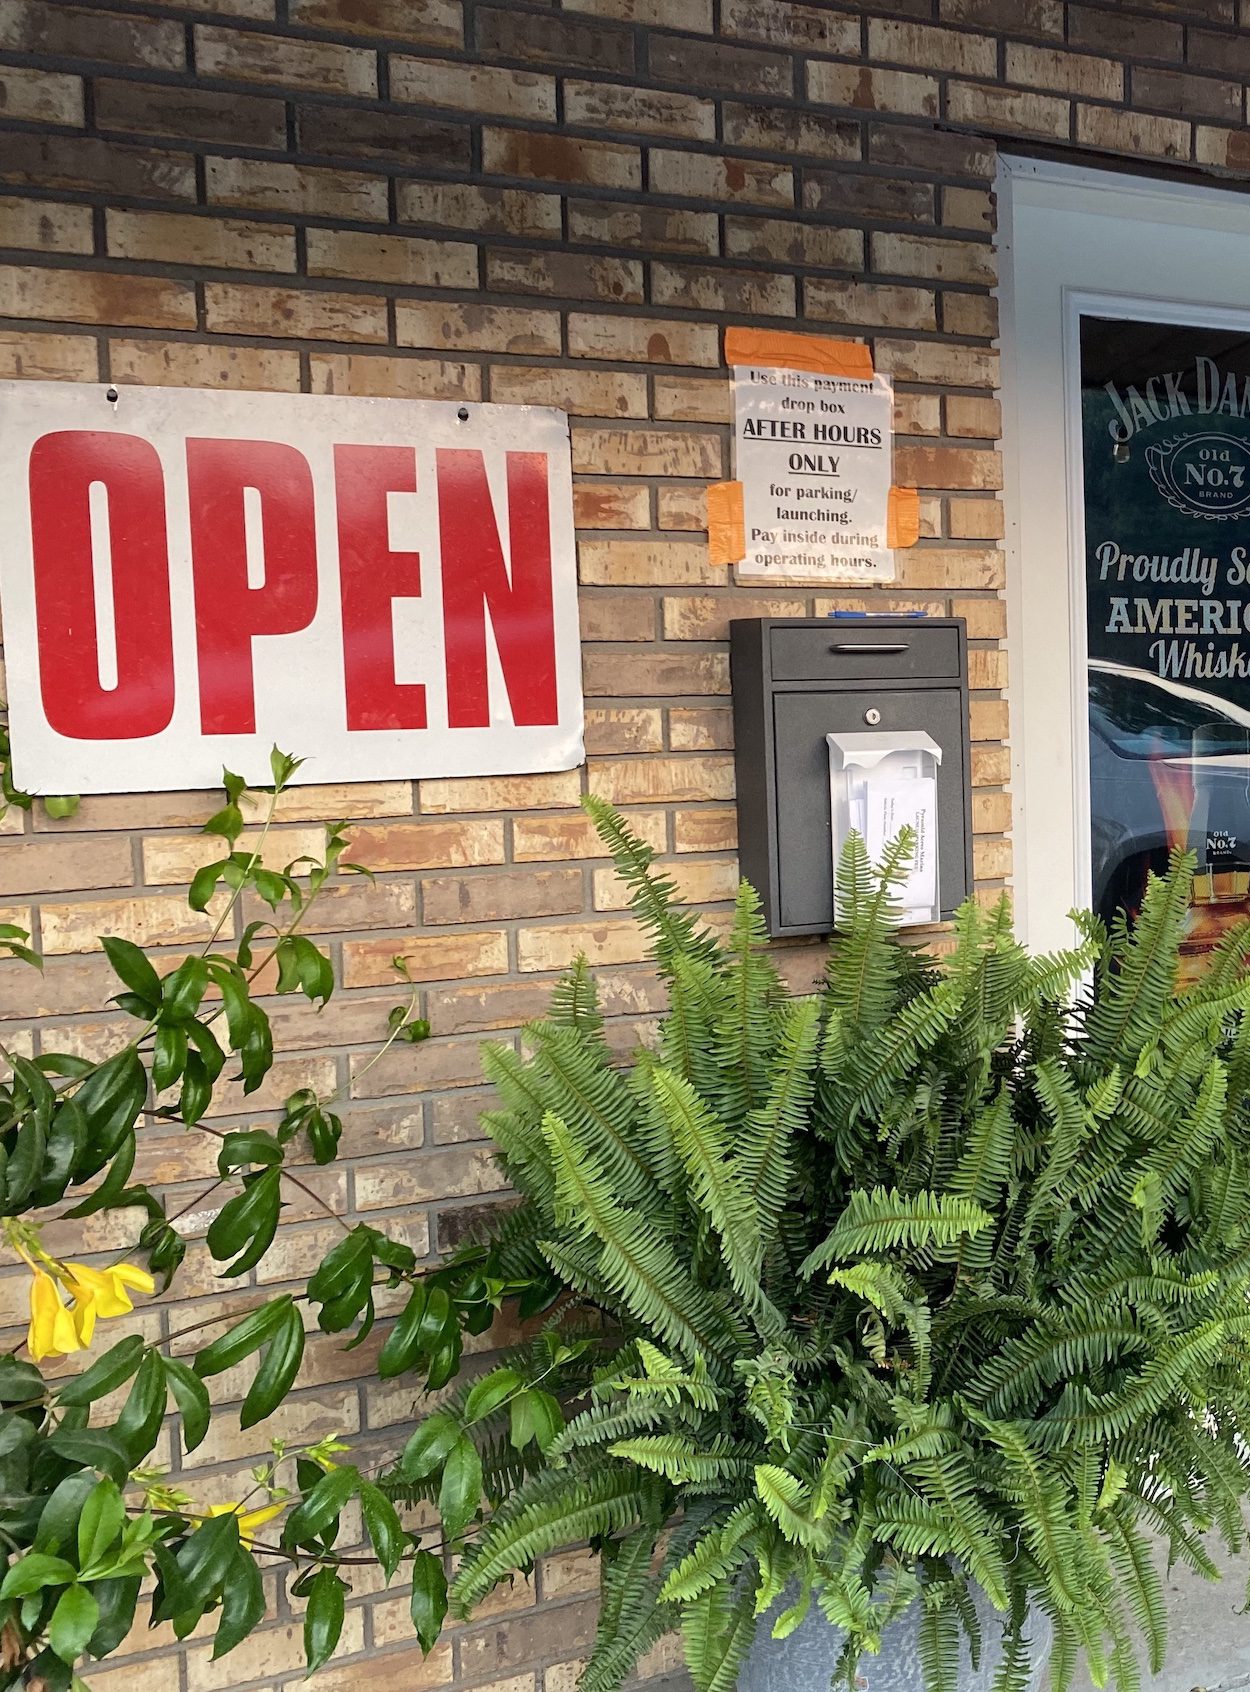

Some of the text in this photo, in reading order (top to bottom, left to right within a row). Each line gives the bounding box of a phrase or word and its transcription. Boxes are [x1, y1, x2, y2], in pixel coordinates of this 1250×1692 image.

[750, 370, 874, 393] Use this payment
[781, 396, 846, 414] drop box
[1102, 370, 1194, 443] JACK
[743, 418, 882, 445] AFTER HOURS
[789, 453, 840, 473] ONLY
[1199, 449, 1230, 462] Old
[770, 484, 858, 503] for parking/
[1199, 491, 1233, 499] BRAND
[776, 507, 852, 525] launching.
[751, 528, 878, 549] Pay inside during
[755, 552, 877, 569] operating hours.
[1095, 541, 1219, 596] Proudly
[29, 429, 559, 740] OPEN
